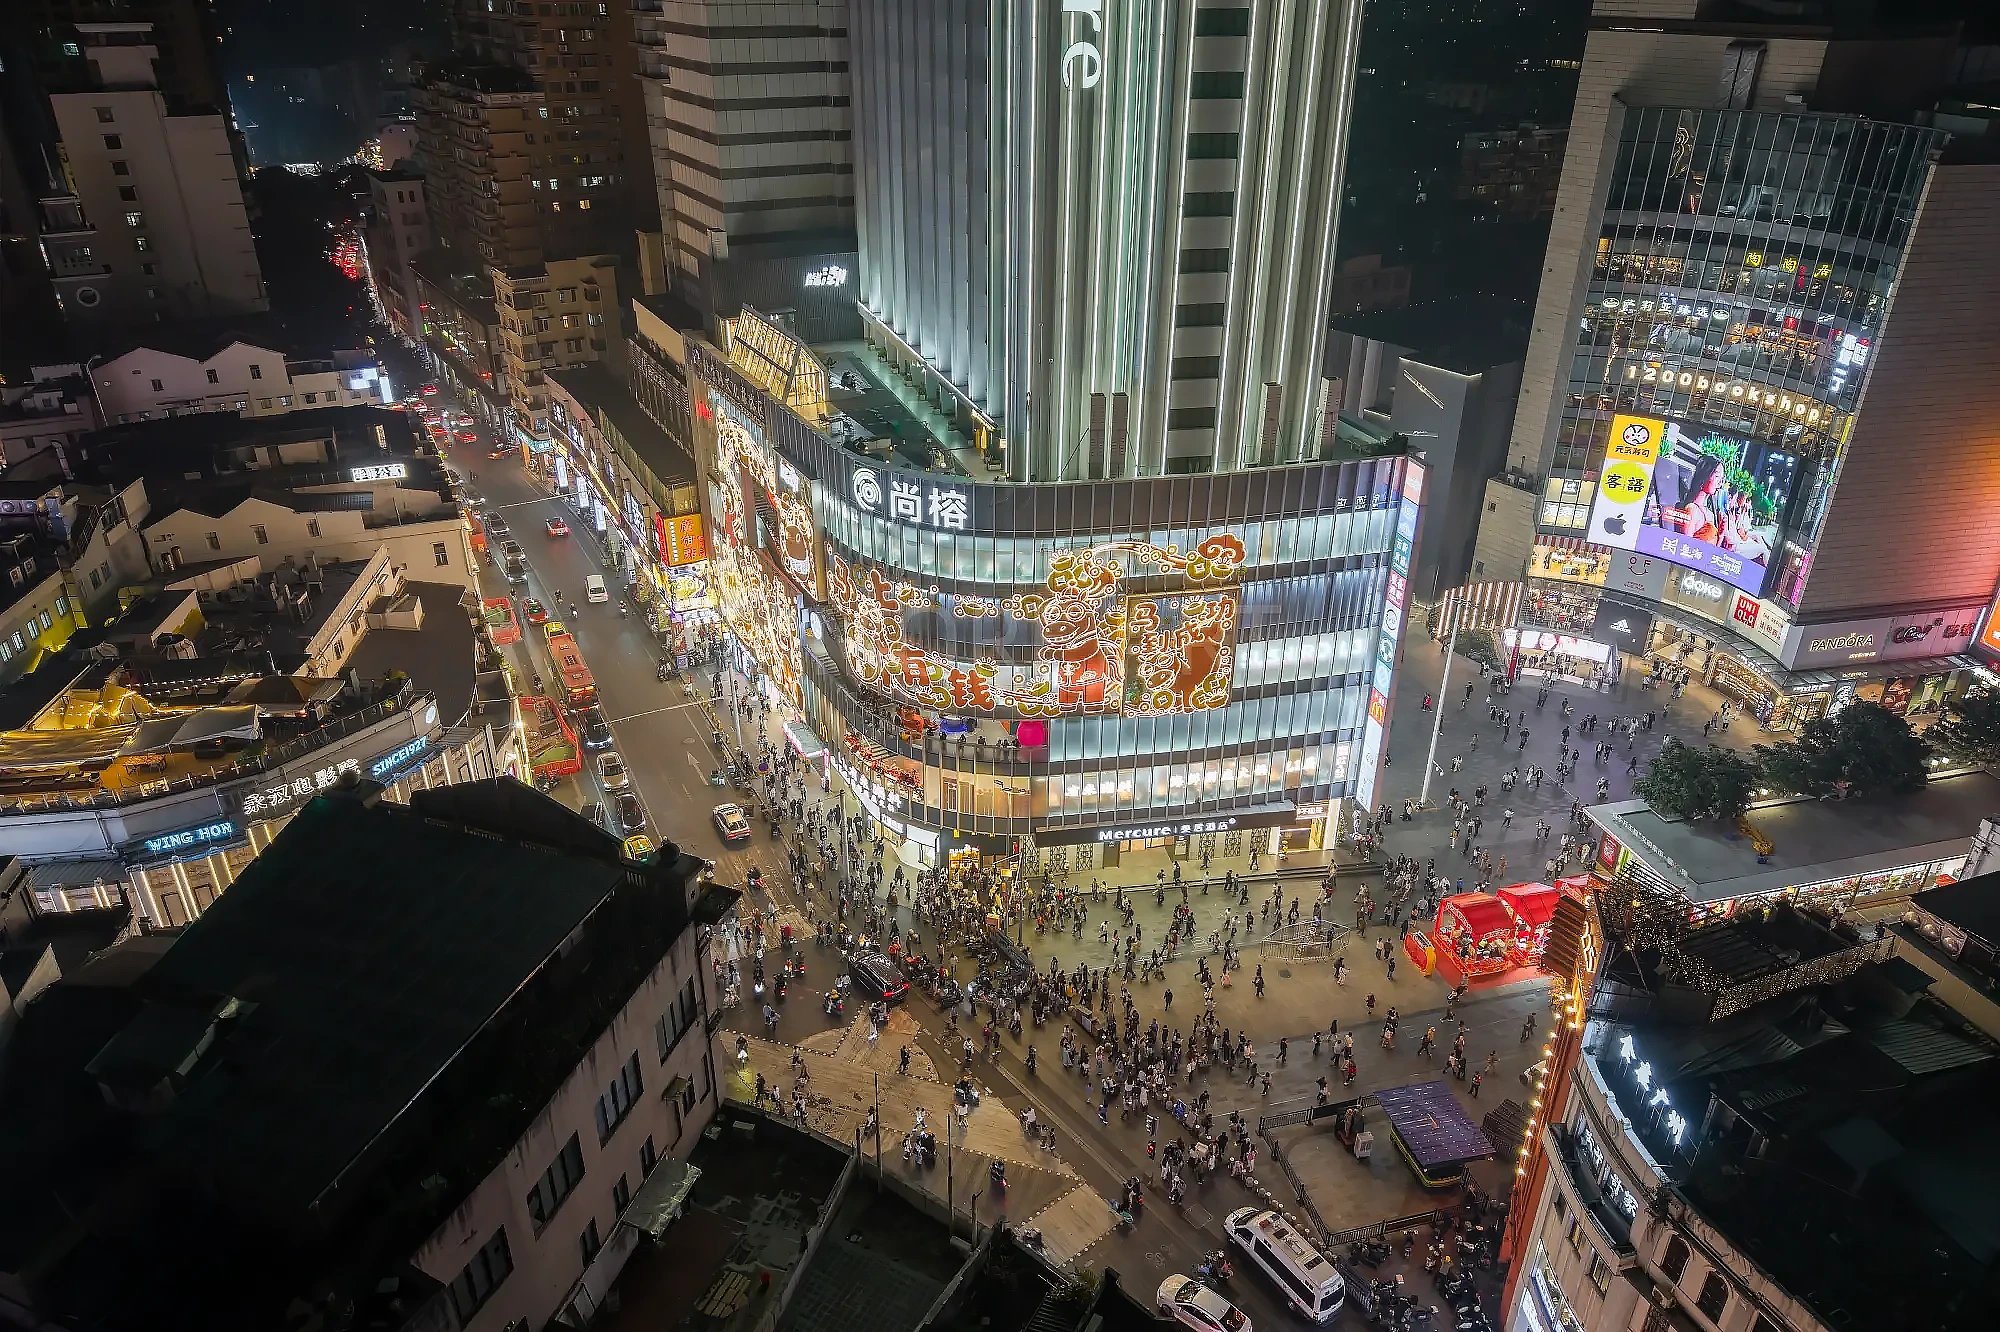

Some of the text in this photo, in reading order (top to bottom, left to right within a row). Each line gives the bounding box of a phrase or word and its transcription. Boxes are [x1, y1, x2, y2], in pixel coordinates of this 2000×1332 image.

[1744, 251, 1833, 279] 陶陶居
[890, 480, 968, 529] 尚榕
[1737, 609, 1754, 624] QLO
[1739, 598, 1757, 614] UNI
[1809, 634, 1874, 652] PANDORA
[371, 735, 429, 777] SINCE1927
[243, 757, 361, 815] 永汉电影院
[146, 821, 232, 852] WING HON
[1098, 825, 1172, 842] Mercure
